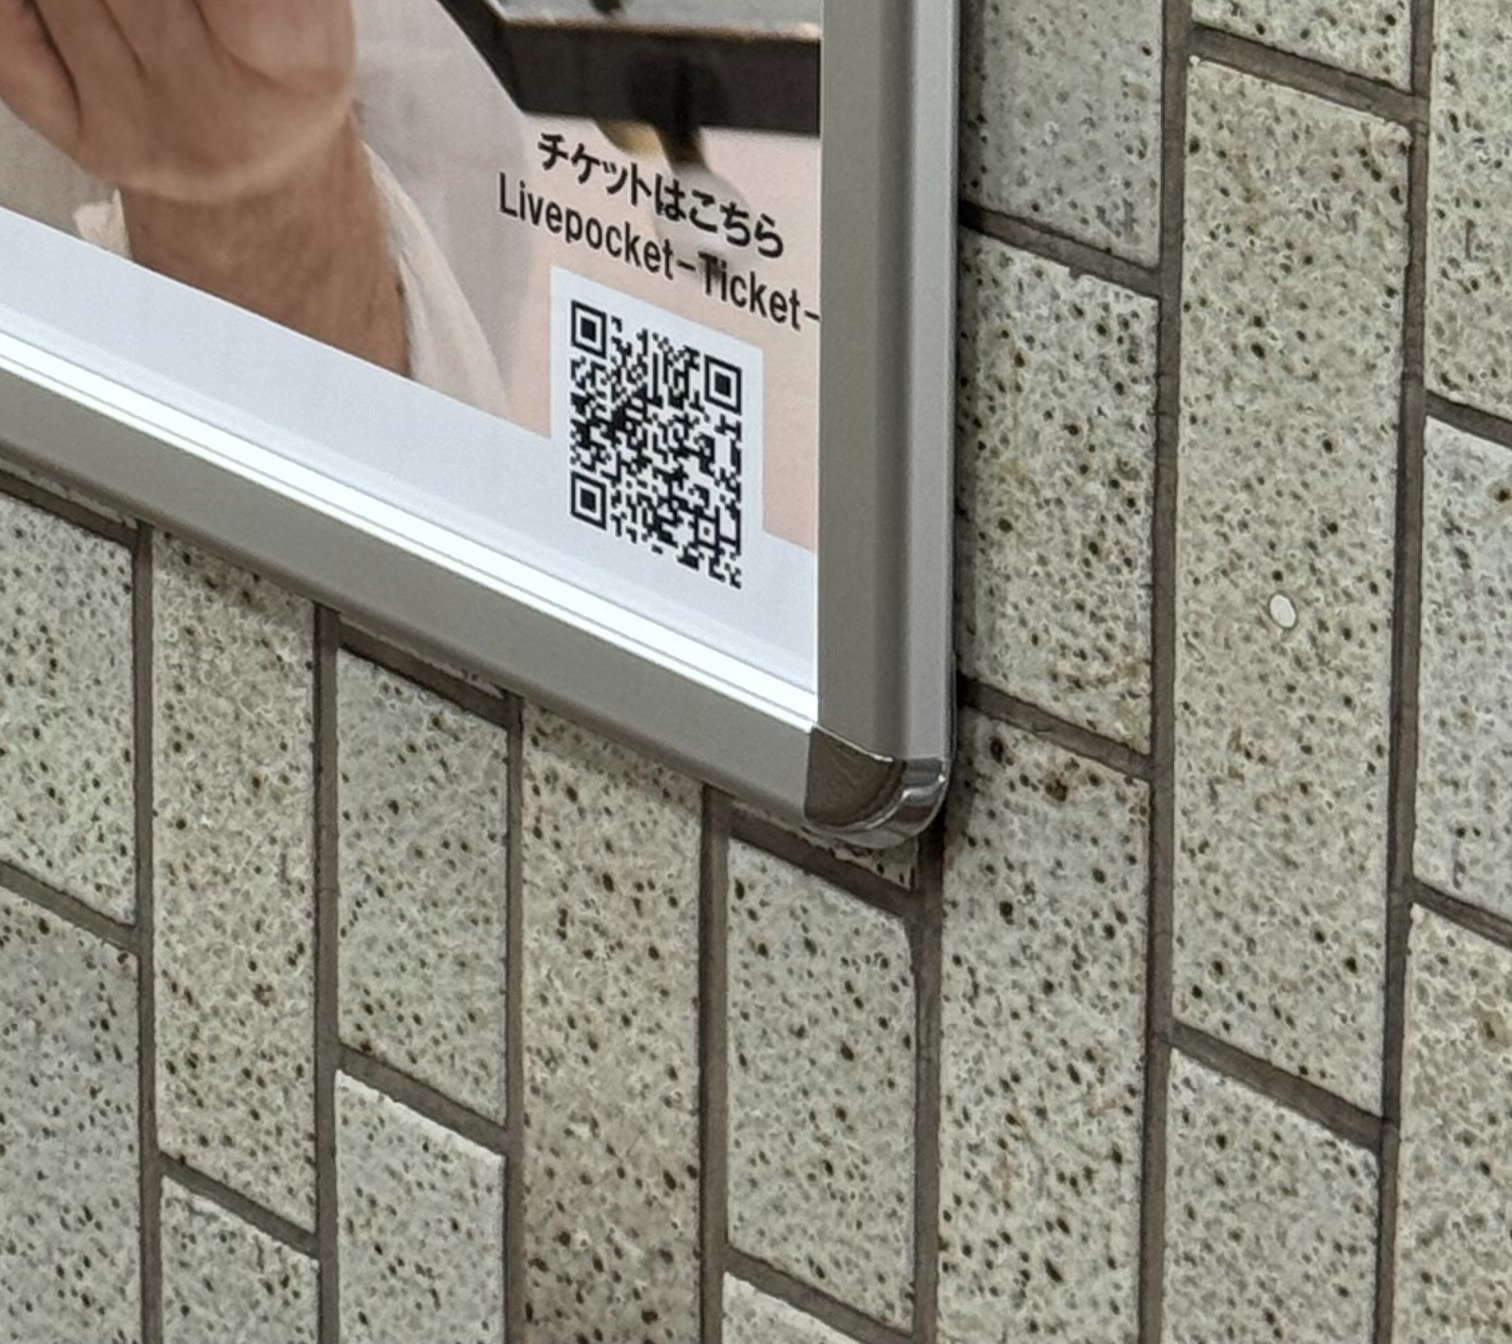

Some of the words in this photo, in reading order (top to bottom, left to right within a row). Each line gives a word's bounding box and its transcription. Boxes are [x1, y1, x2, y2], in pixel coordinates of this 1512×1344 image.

[537, 132, 785, 259] チケットはこちら
